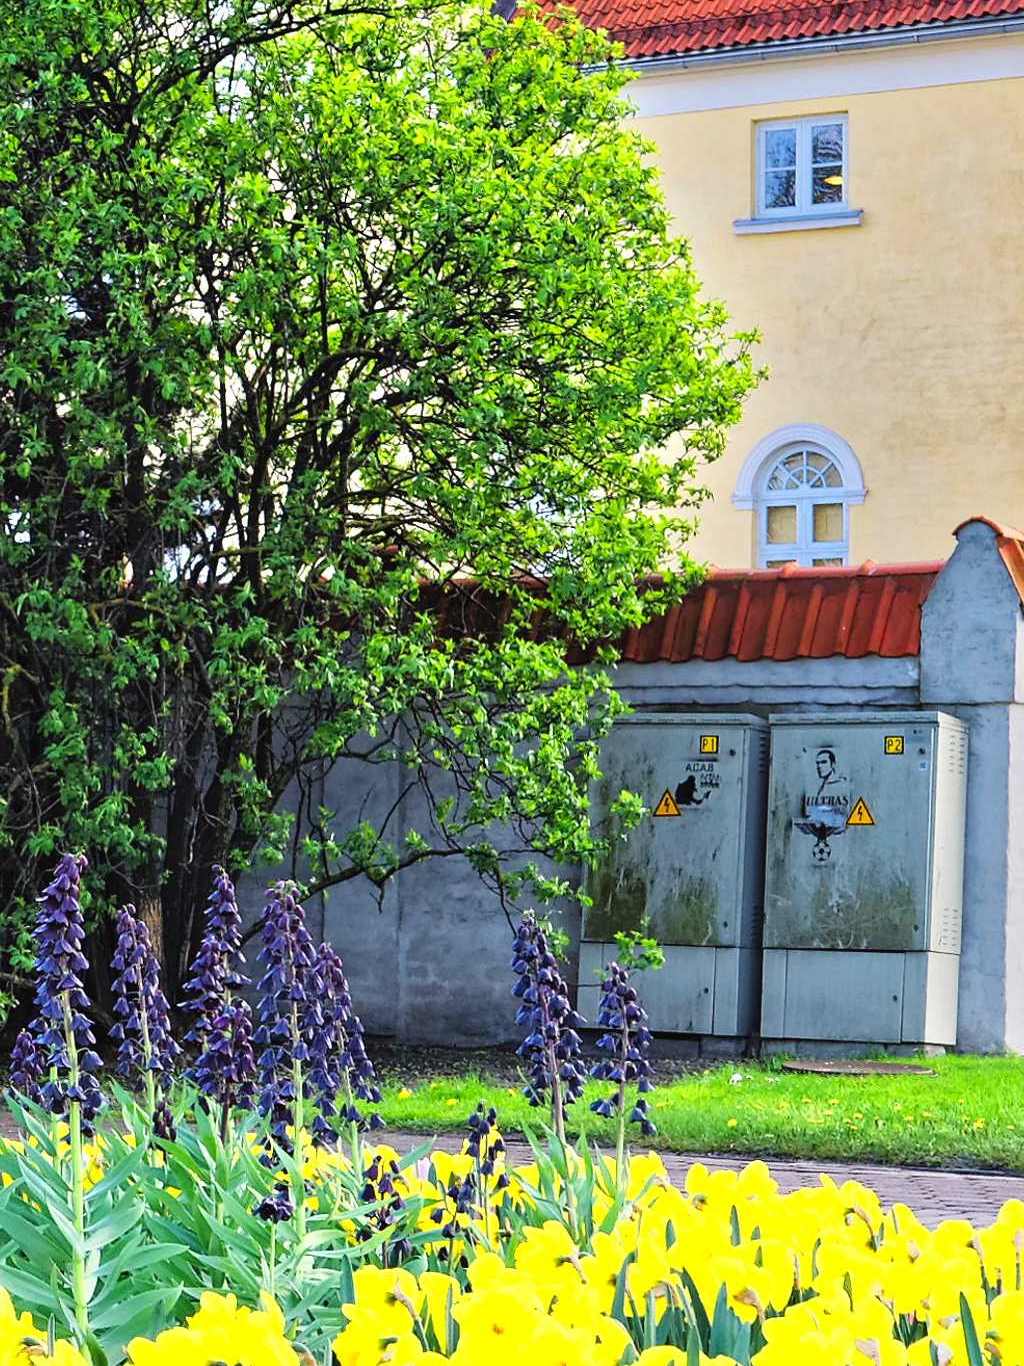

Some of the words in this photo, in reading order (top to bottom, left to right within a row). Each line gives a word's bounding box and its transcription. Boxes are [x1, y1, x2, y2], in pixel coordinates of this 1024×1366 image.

[702, 738, 714, 750] P1
[887, 739, 901, 751] P2
[806, 795, 849, 806] ULTRAS
